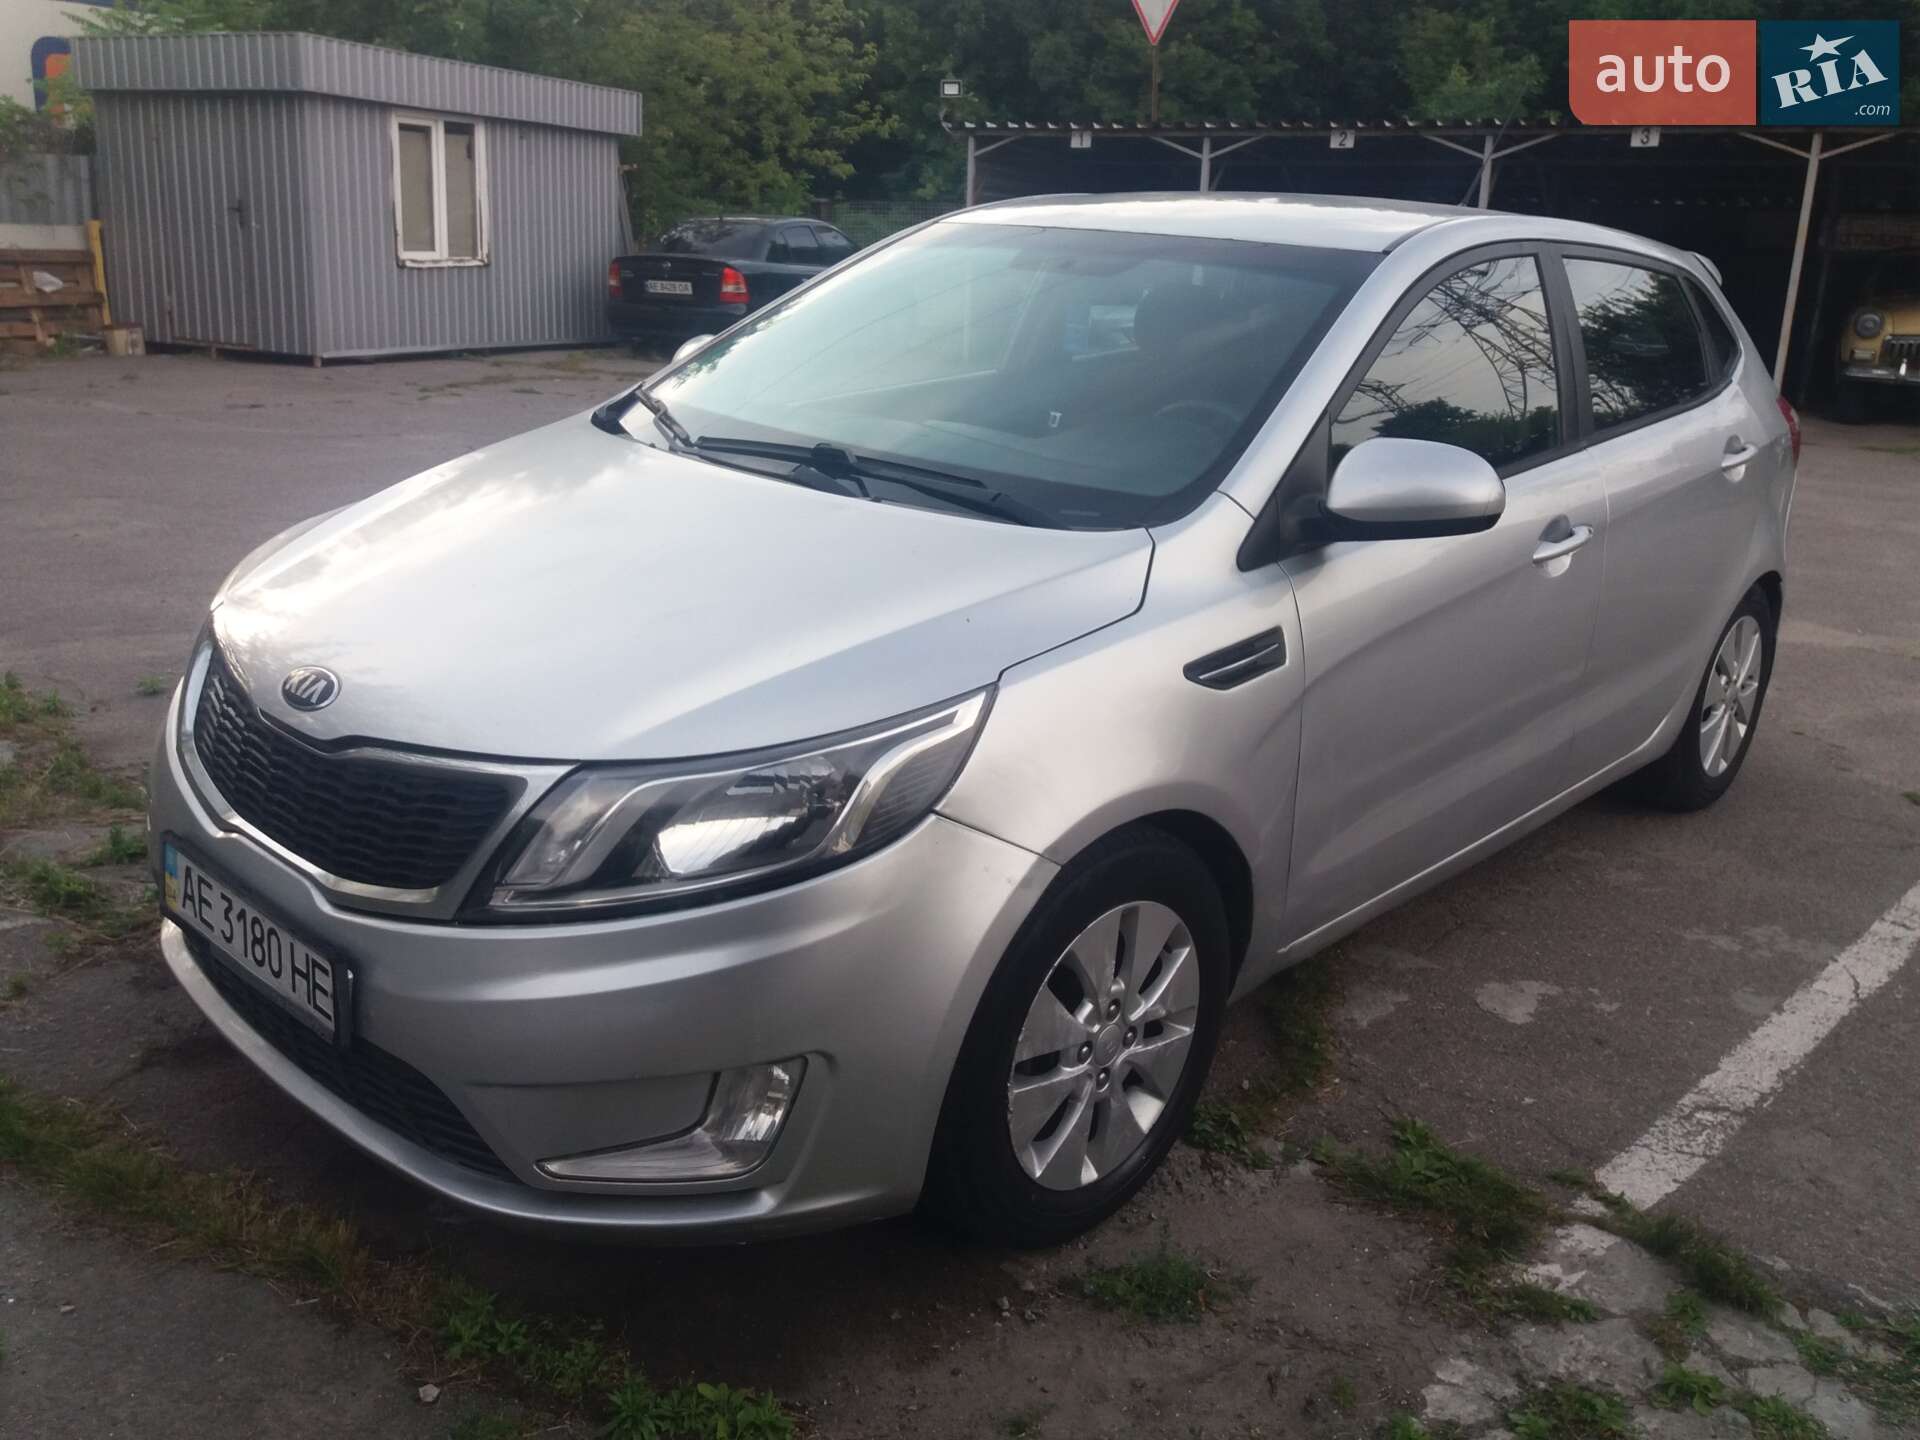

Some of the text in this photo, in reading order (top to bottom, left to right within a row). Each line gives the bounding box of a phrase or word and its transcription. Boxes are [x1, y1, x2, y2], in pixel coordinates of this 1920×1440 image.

[1338, 131, 1348, 147] 2
[1640, 128, 1650, 145] 3
[285, 672, 328, 704] KIA
[182, 865, 333, 1023] AE 3180 HE
